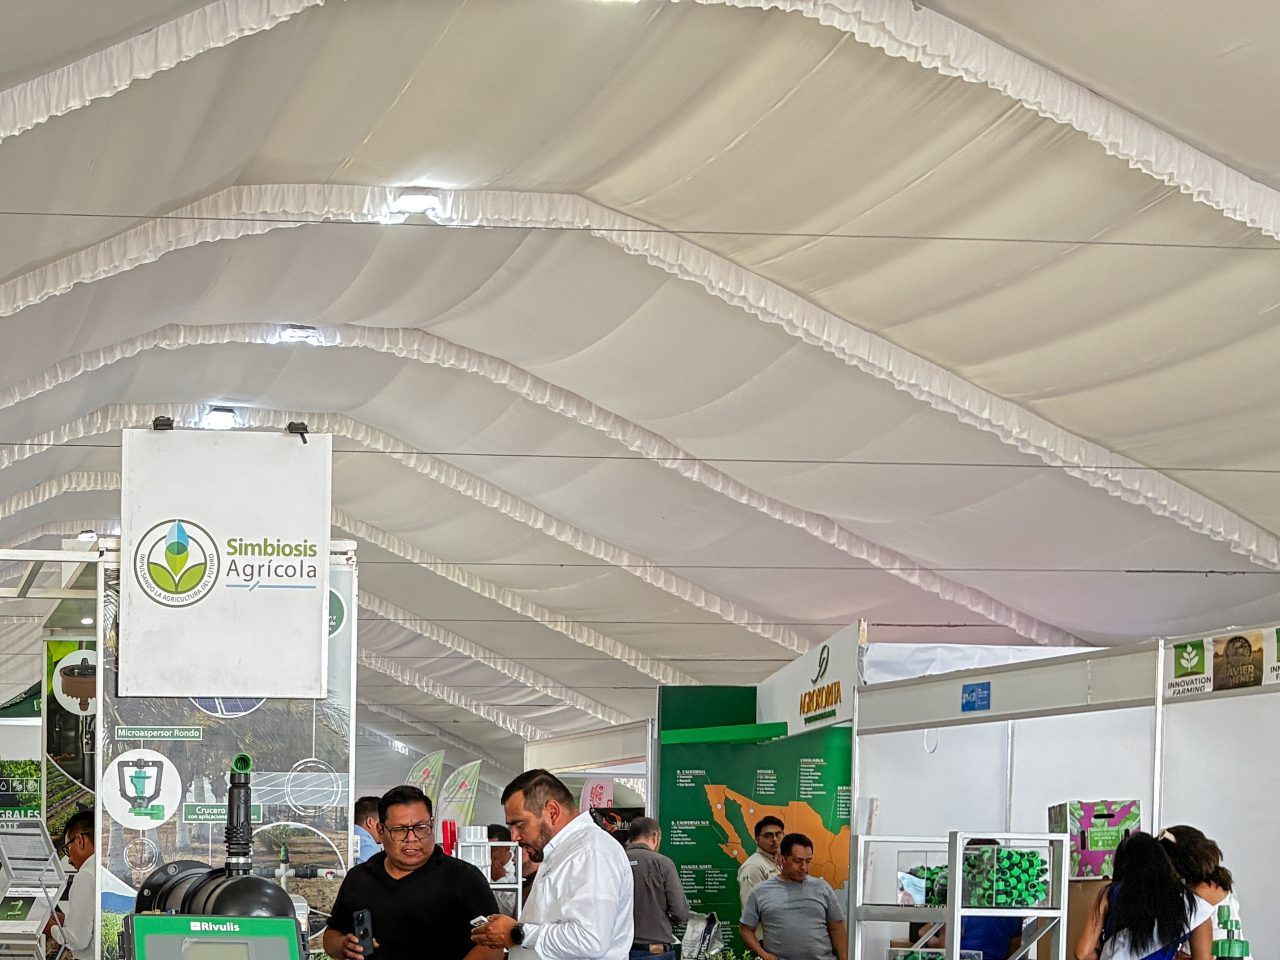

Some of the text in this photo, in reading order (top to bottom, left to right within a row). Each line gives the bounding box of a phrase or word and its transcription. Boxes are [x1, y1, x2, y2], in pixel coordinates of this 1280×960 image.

[226, 538, 318, 557] Simbiosis
[226, 559, 317, 581] Agrícola
[140, 553, 215, 603] IMPULSANDO LA AGRICULTURA DEL FUTURO
[1167, 676, 1212, 689] INNOVATION
[1172, 685, 1206, 696] FARMING
[118, 728, 199, 738] Microaspersor Rondo
[196, 806, 226, 814] Crucero
[202, 921, 240, 932] Rivulis
